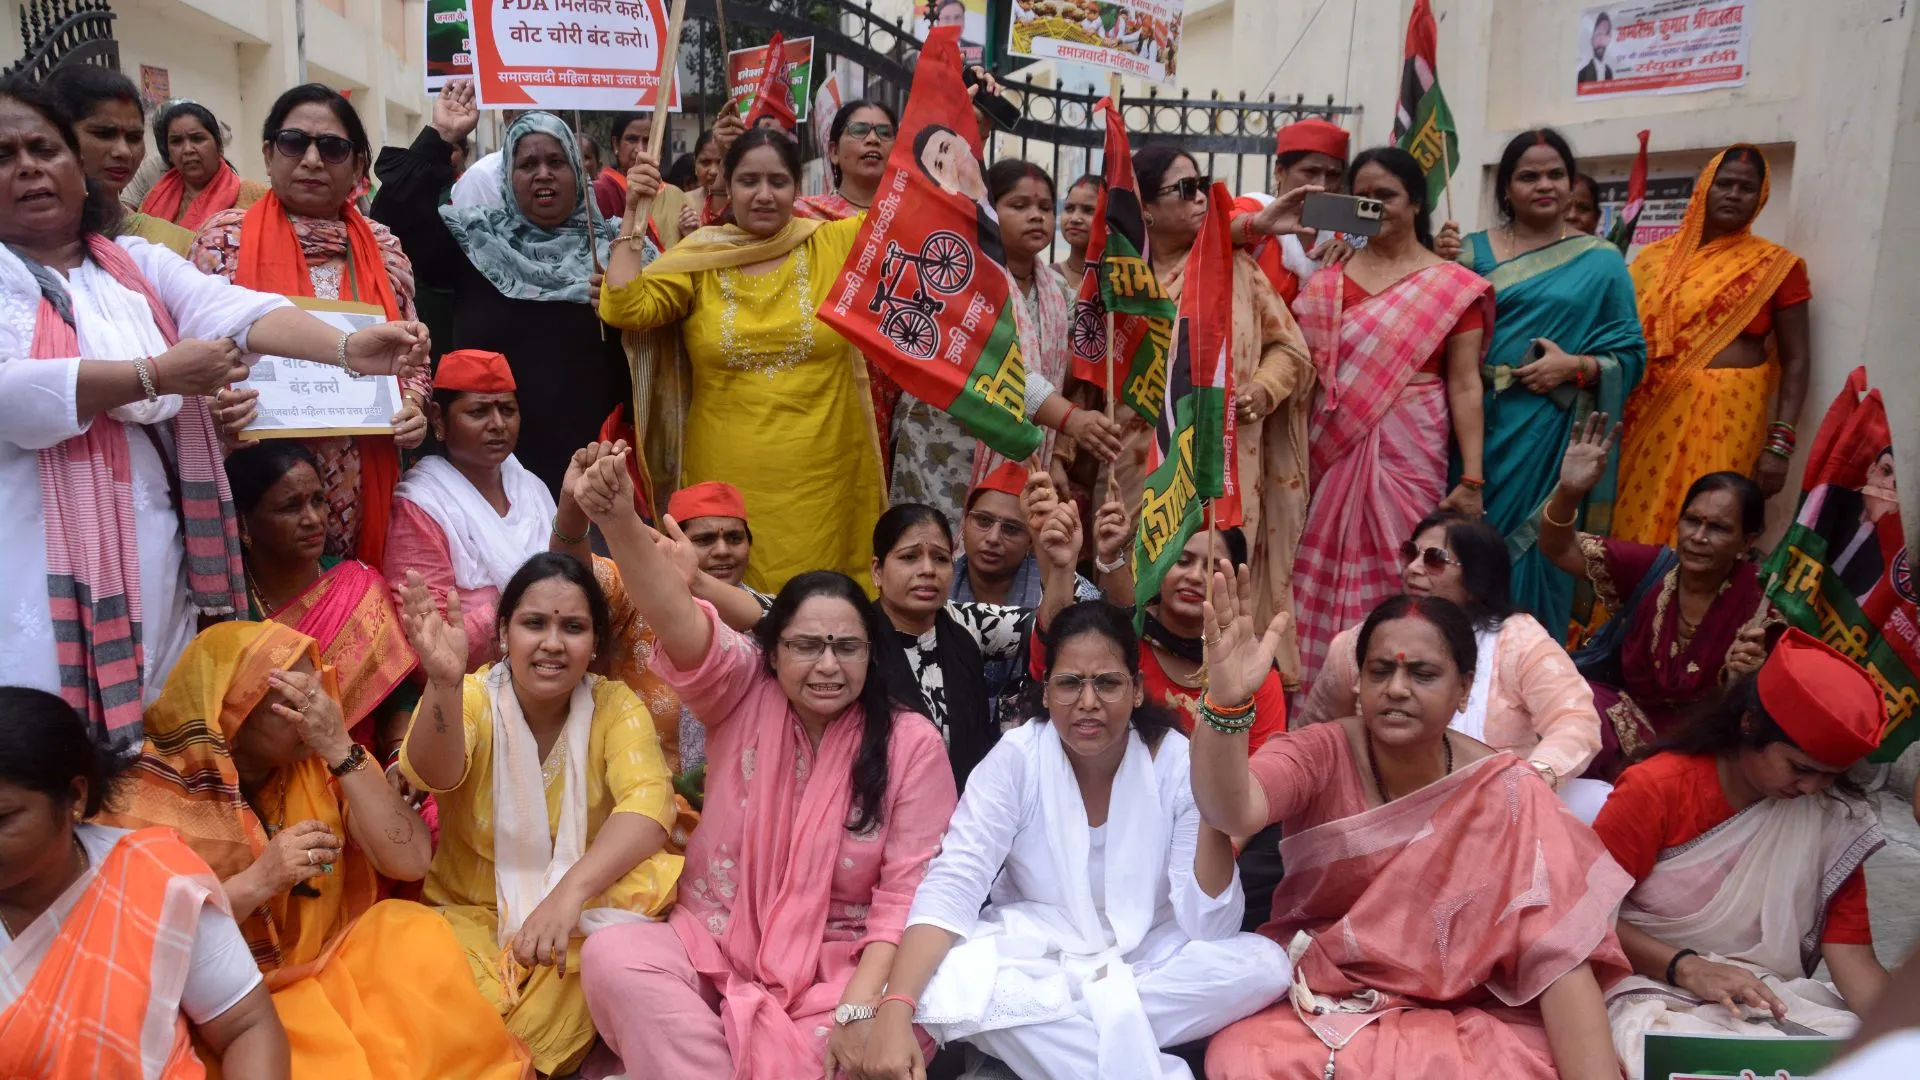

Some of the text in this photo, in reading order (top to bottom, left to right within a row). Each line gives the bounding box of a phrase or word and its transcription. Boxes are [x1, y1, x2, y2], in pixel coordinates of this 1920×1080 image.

[509, 21, 542, 43] वोट
[547, 22, 582, 45] चोरी
[587, 25, 610, 47] बंद
[1057, 44, 1107, 63] समाजवादी
[1110, 53, 1134, 70] महिला
[497, 69, 556, 84] समाजवादी
[558, 71, 588, 85] महिला
[591, 73, 613, 85] सभा
[616, 75, 637, 86] उत्तर
[289, 376, 340, 394] बंद करो
[301, 405, 326, 417] महिला
[327, 406, 345, 417] सभा
